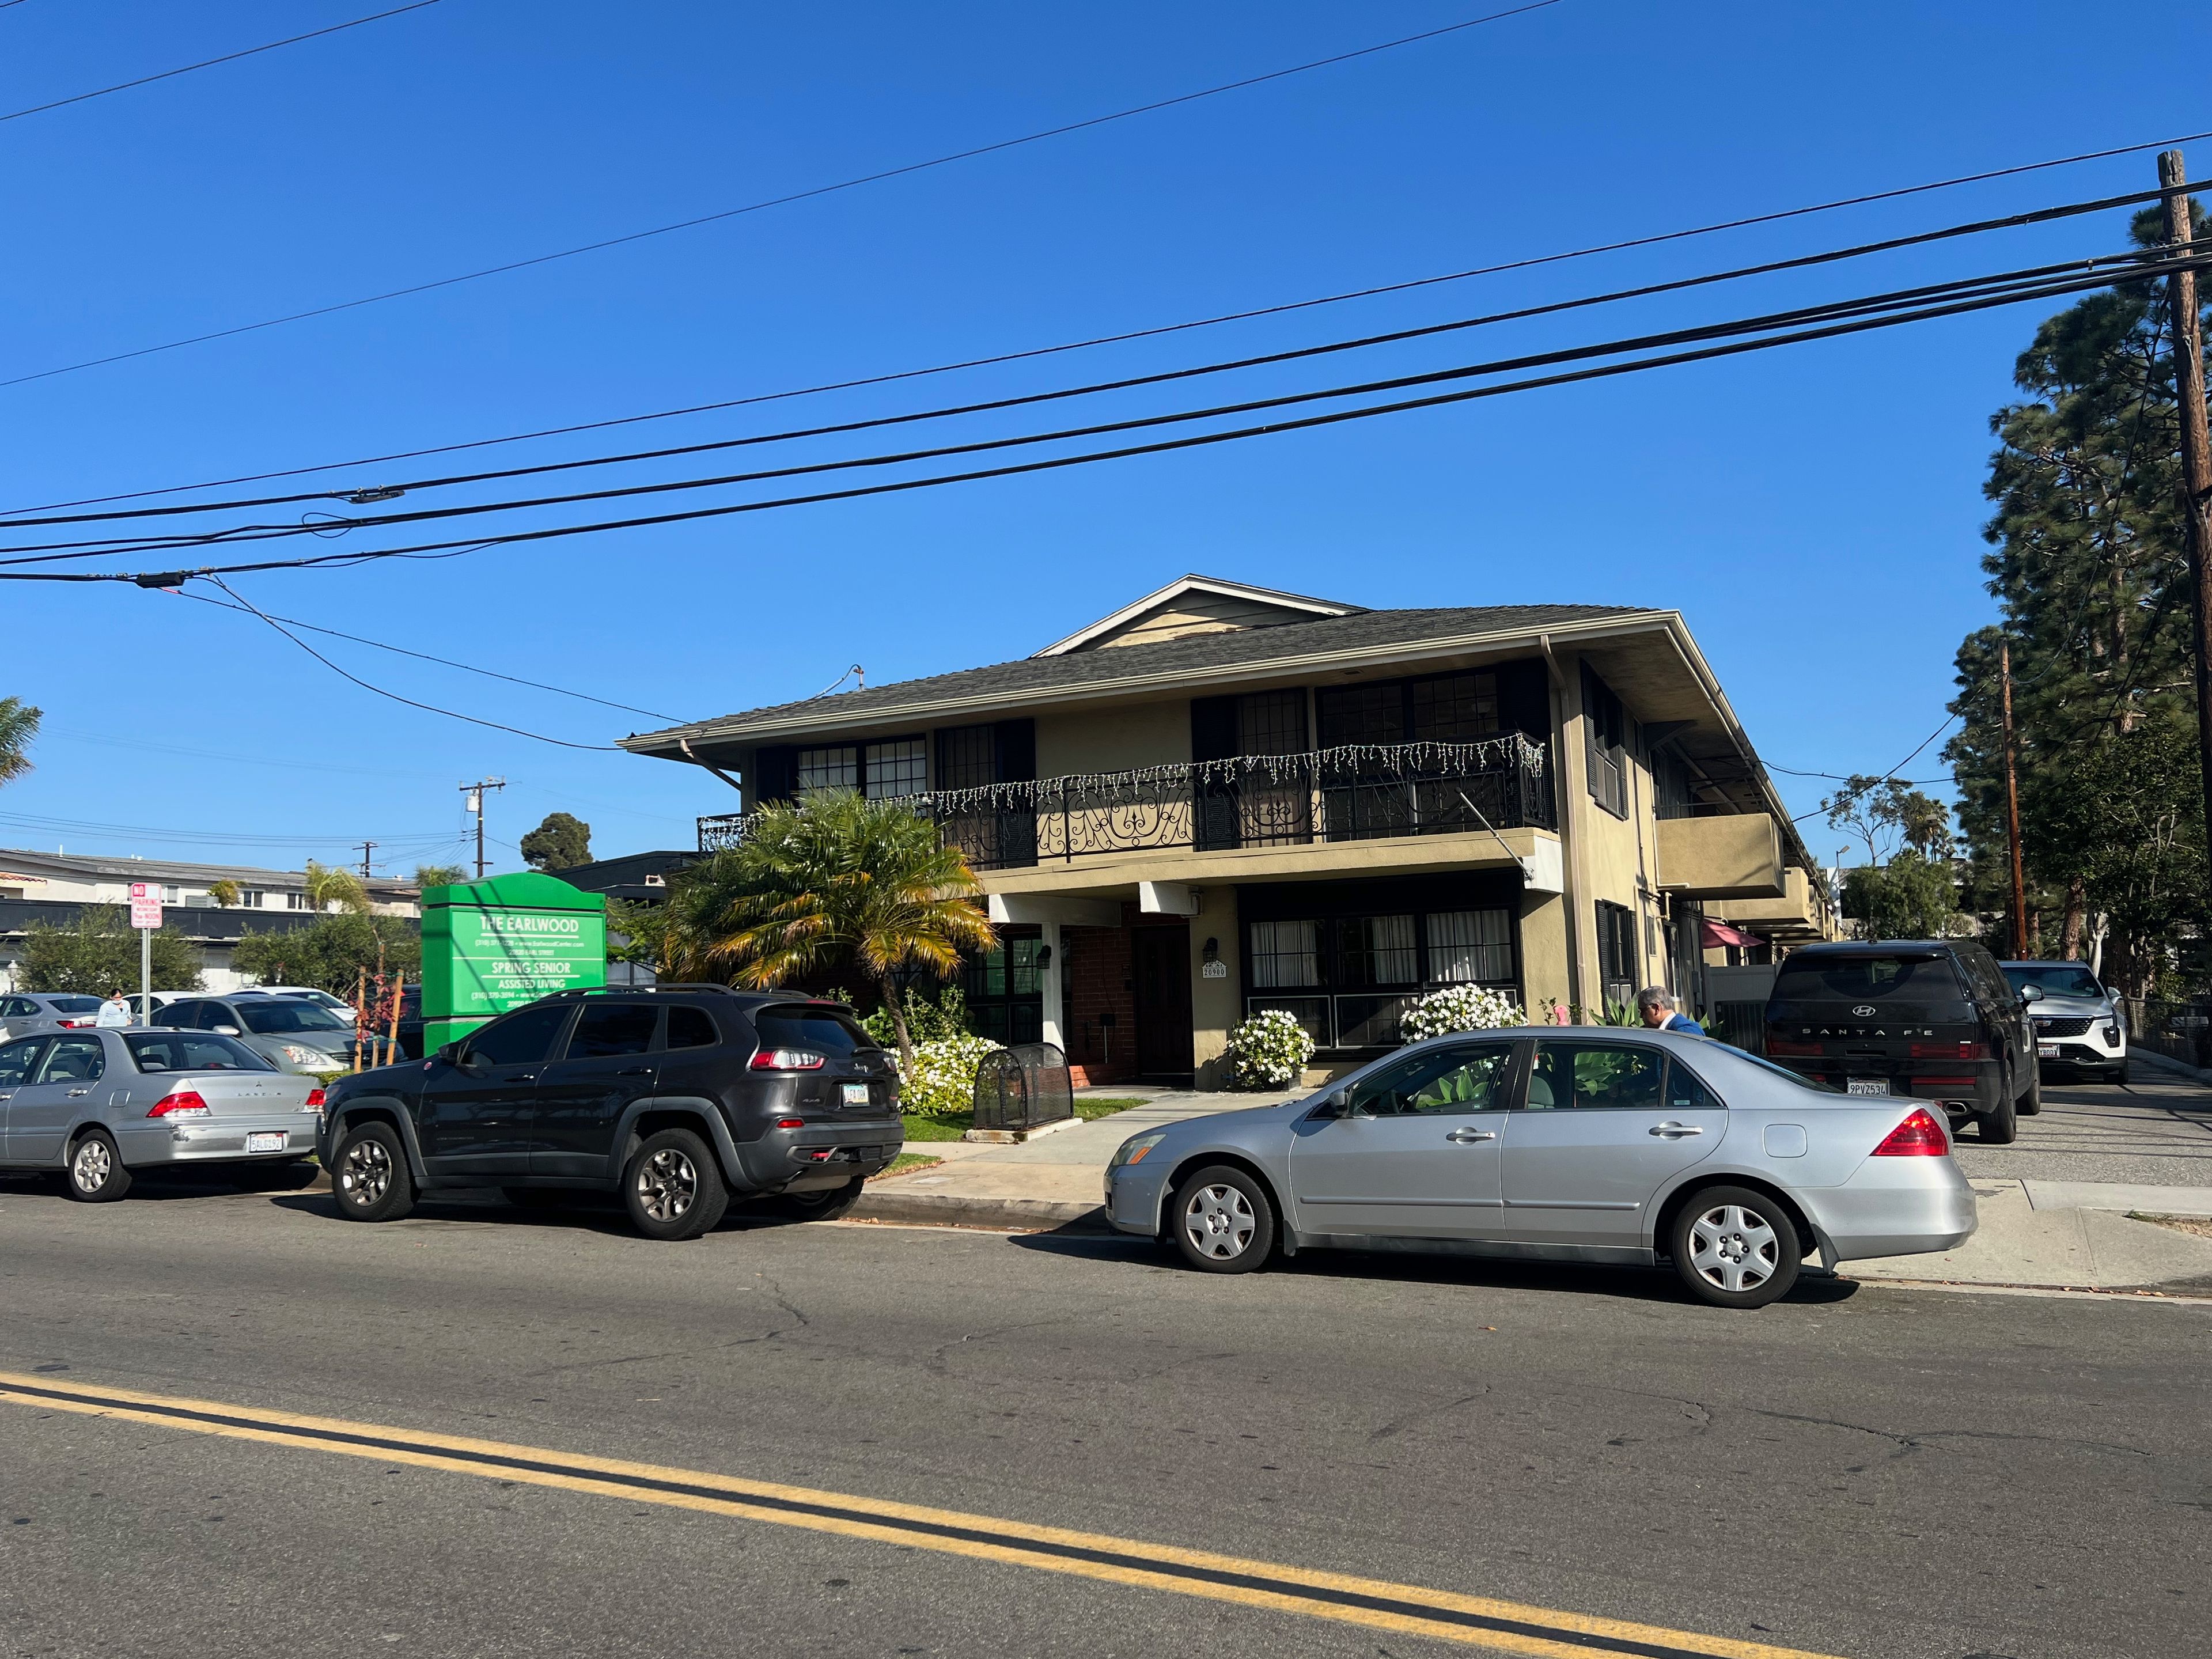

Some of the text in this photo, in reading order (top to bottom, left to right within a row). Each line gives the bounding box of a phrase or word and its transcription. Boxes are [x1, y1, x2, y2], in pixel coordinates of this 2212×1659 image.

[134, 885, 144, 896] NO
[479, 916, 579, 933] THE EARLWOOD
[491, 962, 571, 974] SPRING SENIOR
[498, 979, 566, 989] ASSISTED LIVING
[1802, 1028, 1885, 1036] SANTA
[1850, 1085, 1887, 1094] 9PVZ534
